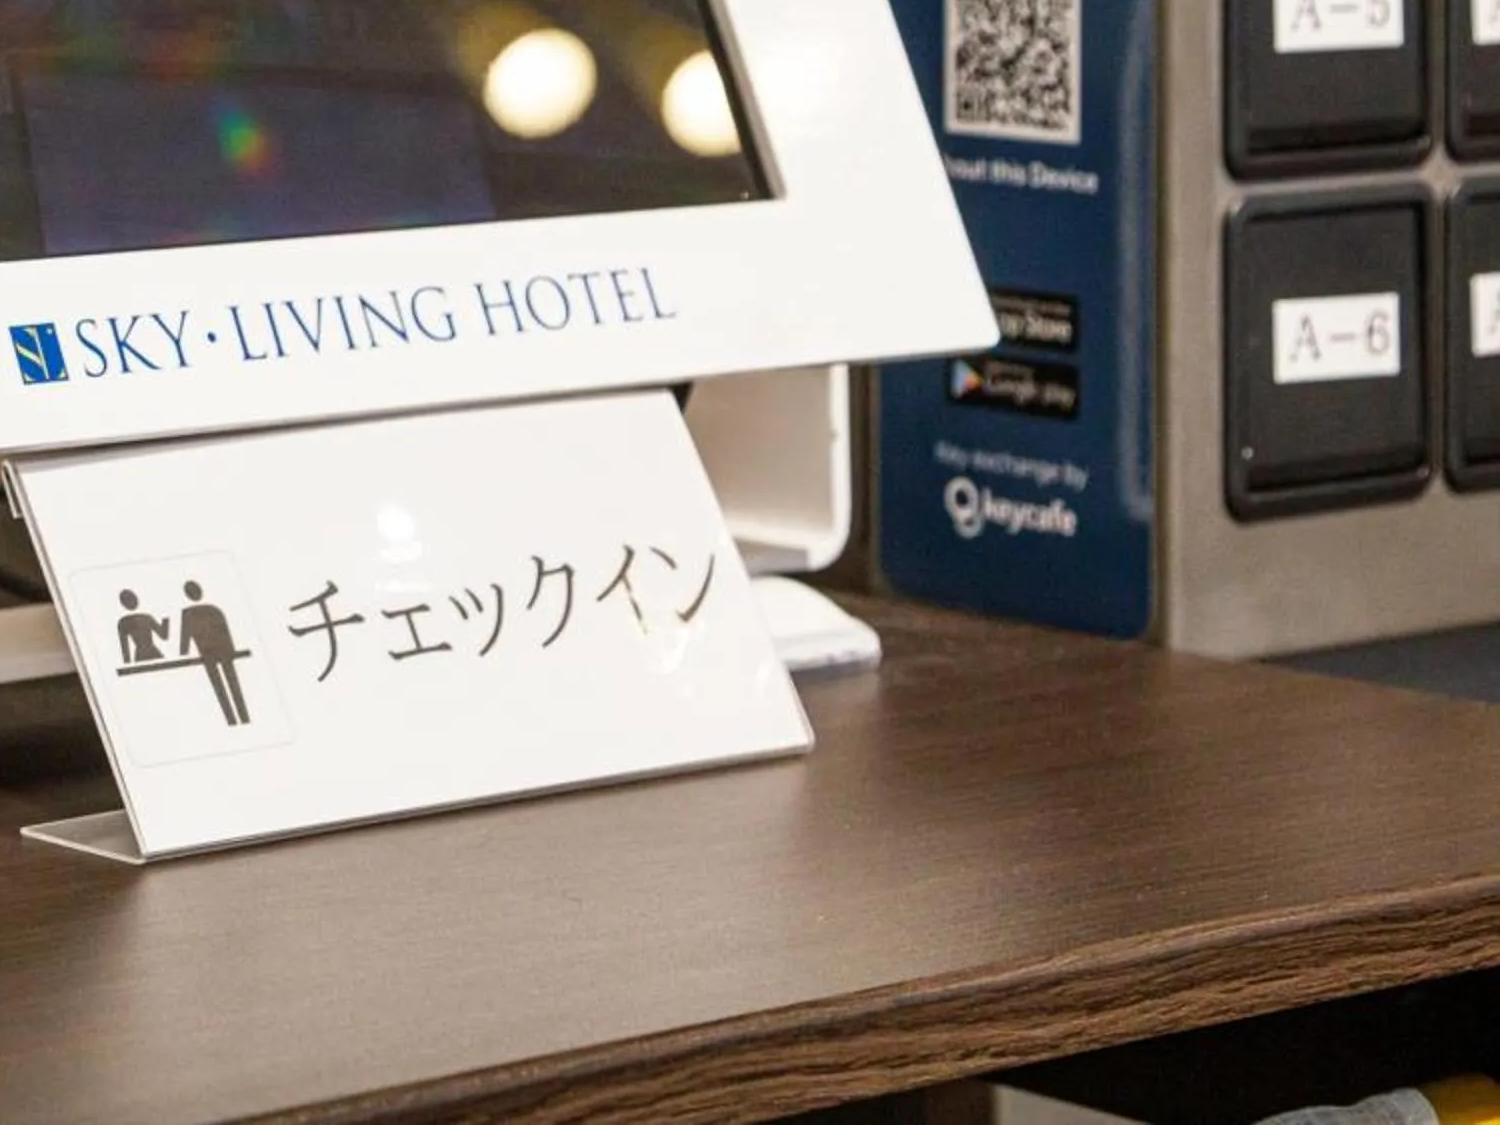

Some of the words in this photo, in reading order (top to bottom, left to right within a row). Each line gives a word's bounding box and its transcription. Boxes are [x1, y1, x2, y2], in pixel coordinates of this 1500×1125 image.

[943, 155, 987, 182] bout
[1027, 160, 1099, 196] Device
[473, 267, 677, 337] HOTEL
[1288, 307, 1391, 362] A-6
[981, 486, 1079, 538] keycafe
[286, 543, 716, 683] チェックイン
